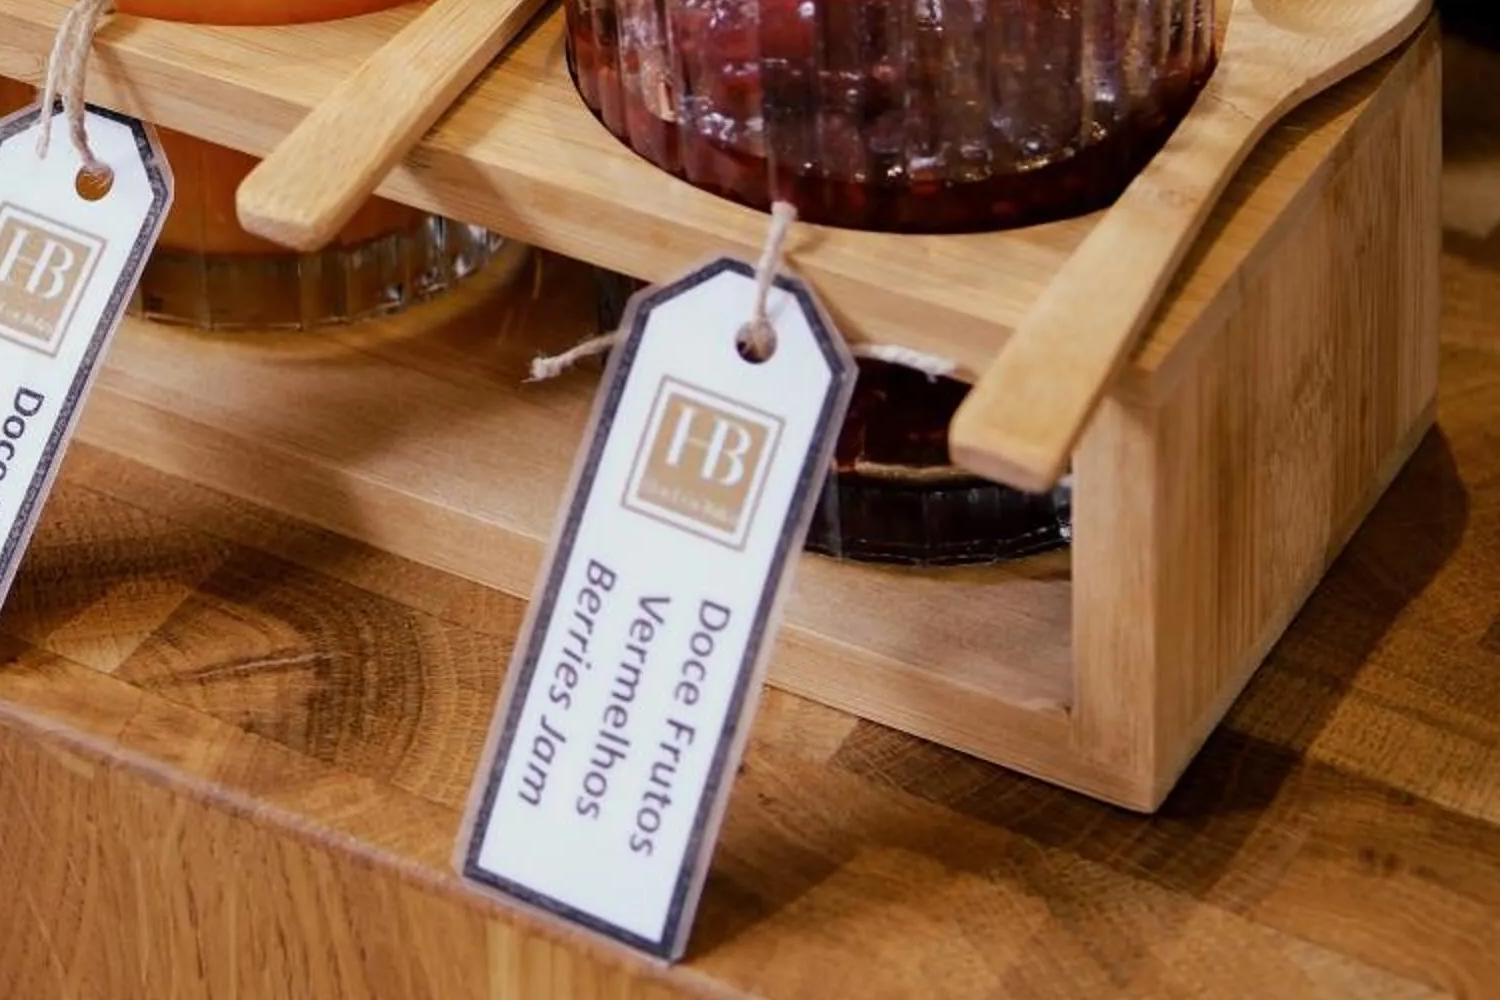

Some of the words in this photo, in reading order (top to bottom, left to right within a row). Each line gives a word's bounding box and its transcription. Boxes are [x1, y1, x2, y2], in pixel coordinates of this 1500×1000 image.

[665, 403, 750, 487] HB
[548, 558, 617, 710] Berries
[674, 599, 732, 706] Doce
[518, 718, 567, 807] Jam
[575, 596, 672, 819] Vermelhos
[629, 718, 696, 856] Frutos
